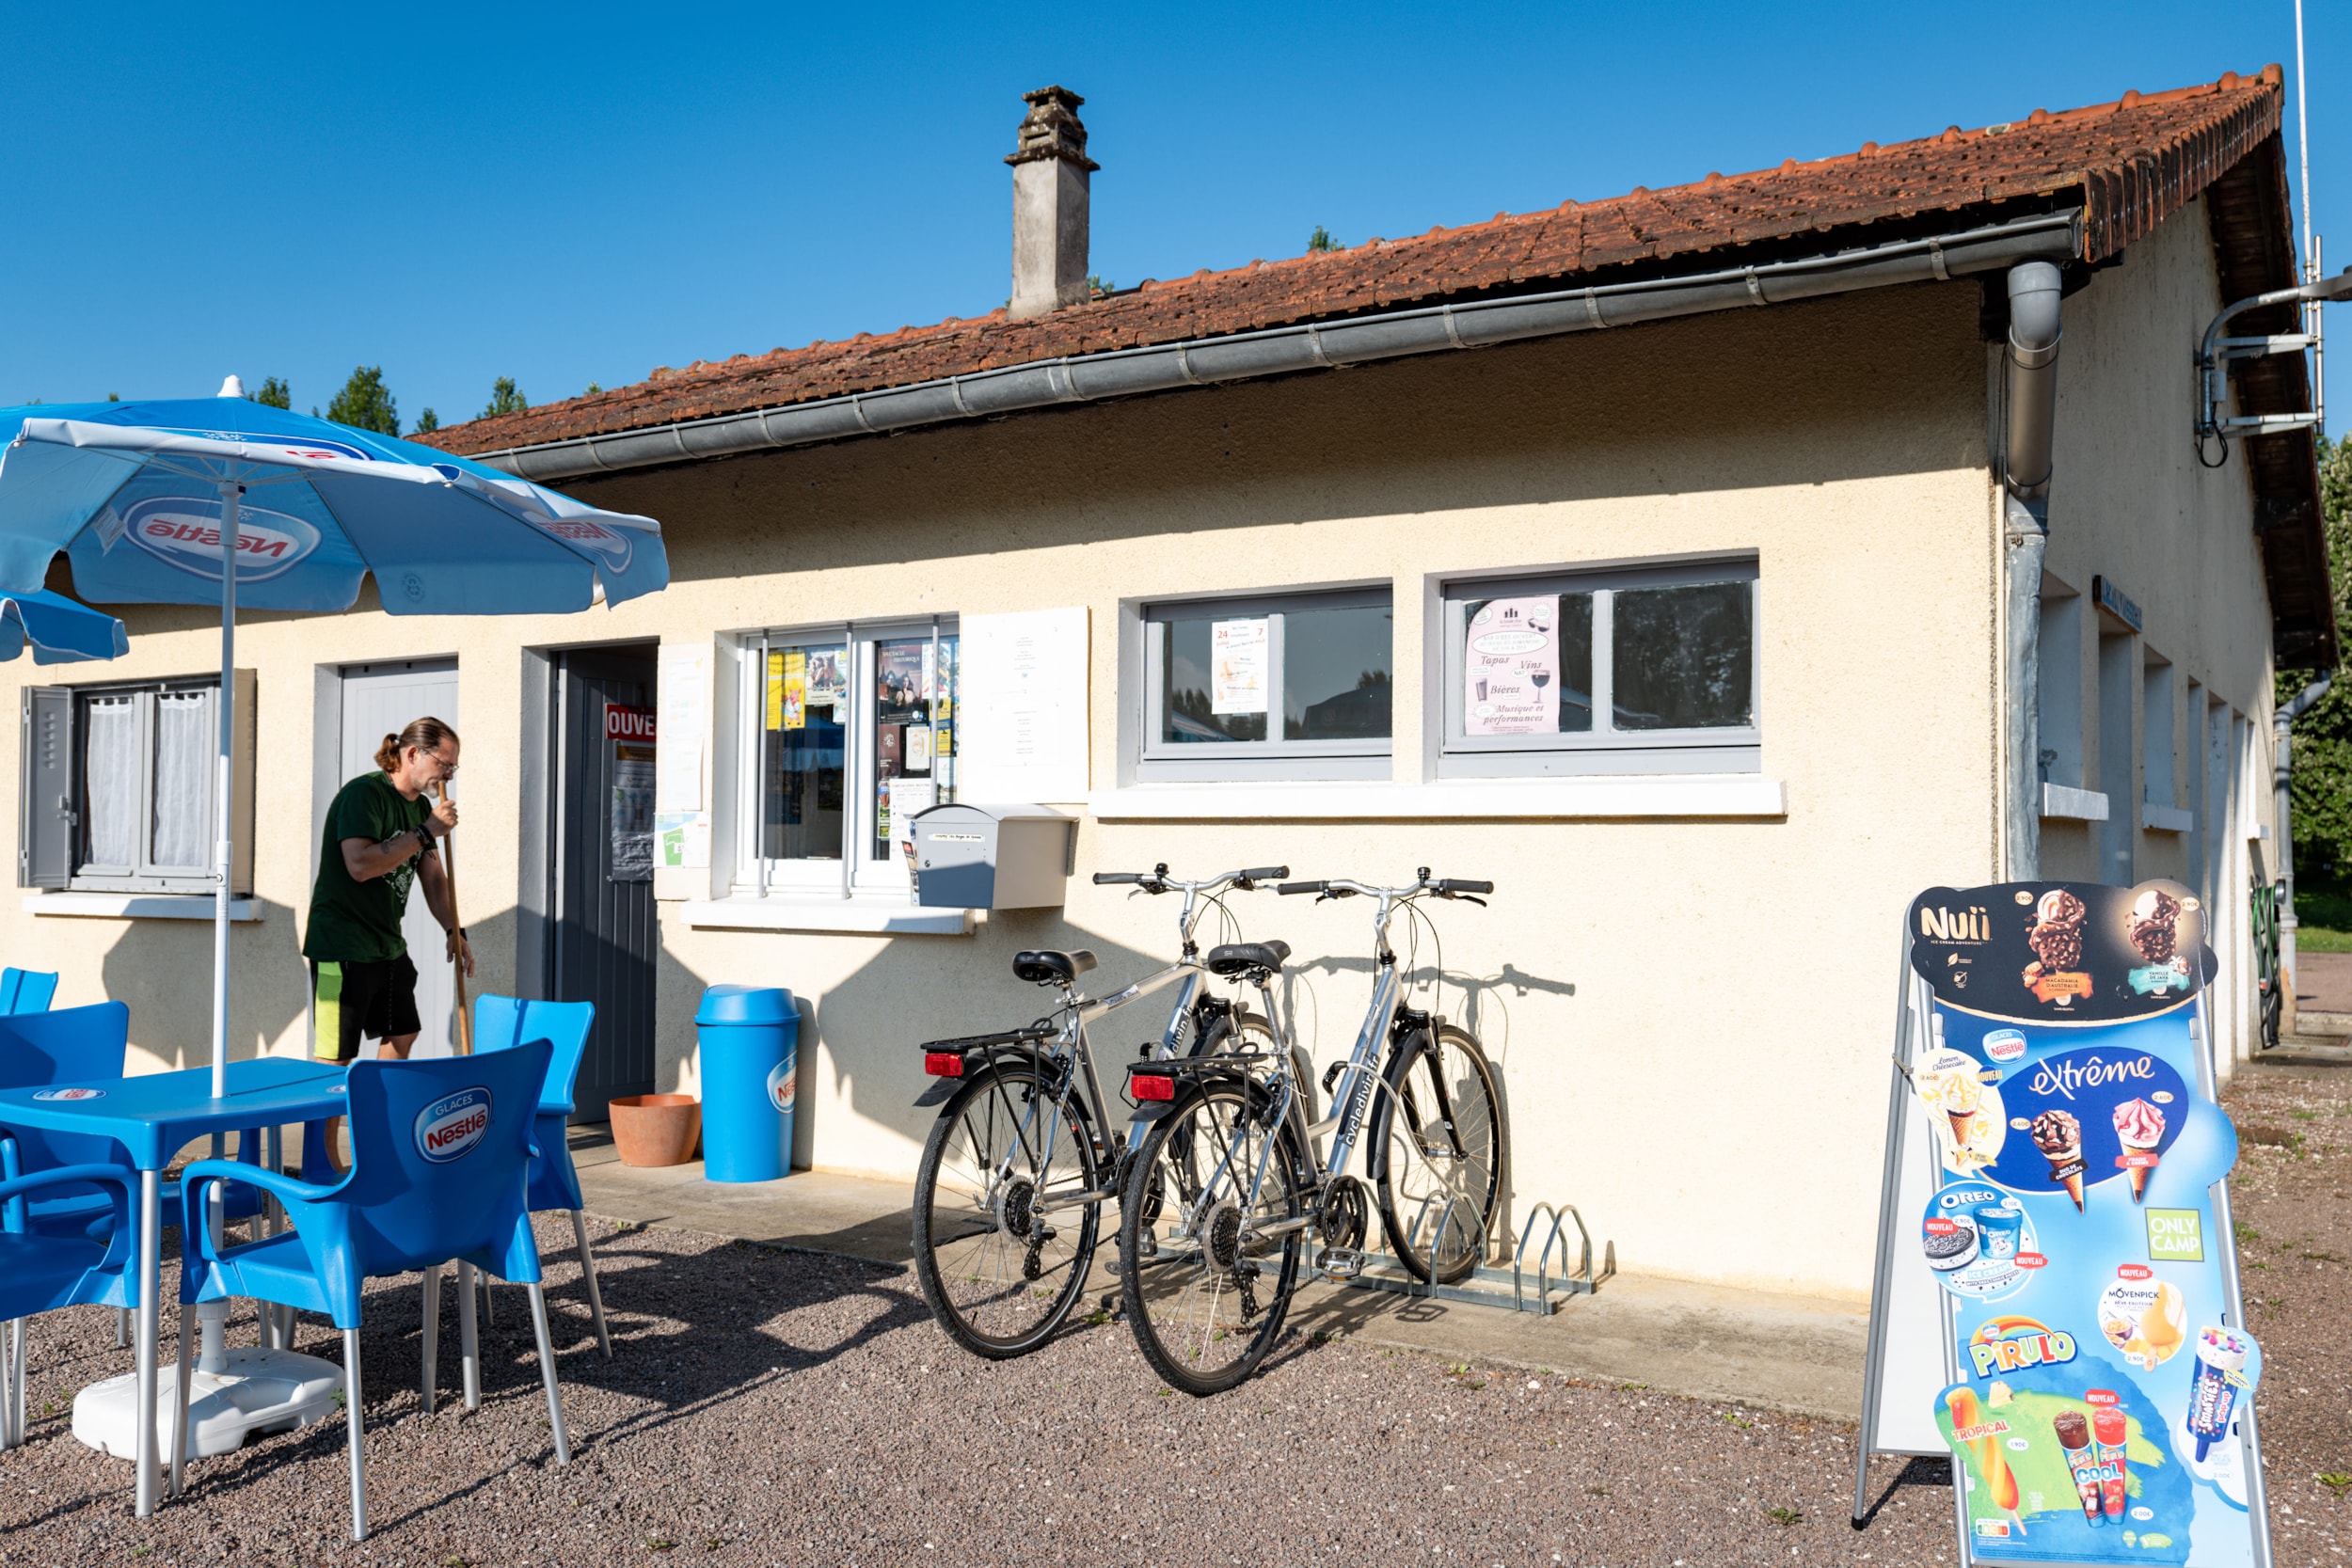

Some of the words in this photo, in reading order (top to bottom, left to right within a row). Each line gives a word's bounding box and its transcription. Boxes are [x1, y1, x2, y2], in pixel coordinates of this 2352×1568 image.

[1481, 656, 1510, 665] Tapas
[1520, 660, 1542, 669] Vins
[1490, 685, 1520, 694] Bières
[1496, 705, 1534, 715] Musique
[608, 711, 656, 736] OUVE
[1483, 715, 1544, 726] performances
[1991, 1041, 2025, 1057] Nestlé
[1931, 1060, 1966, 1071] Cheesecake
[1939, 1055, 1960, 1065] Lemon
[435, 1094, 473, 1117] GLACES
[427, 1109, 486, 1151] Nestlé
[1940, 1191, 1995, 1209] OREO
[1927, 1223, 1954, 1231] NOUVEAU
[2150, 1217, 2196, 1234] ONLY
[2152, 1235, 2200, 1252] CAMP
[2016, 1257, 2043, 1265] NOUVEAU
[2087, 1394, 2115, 1403] NOUVEAU
[1952, 1420, 2010, 1441] TROPICAL
